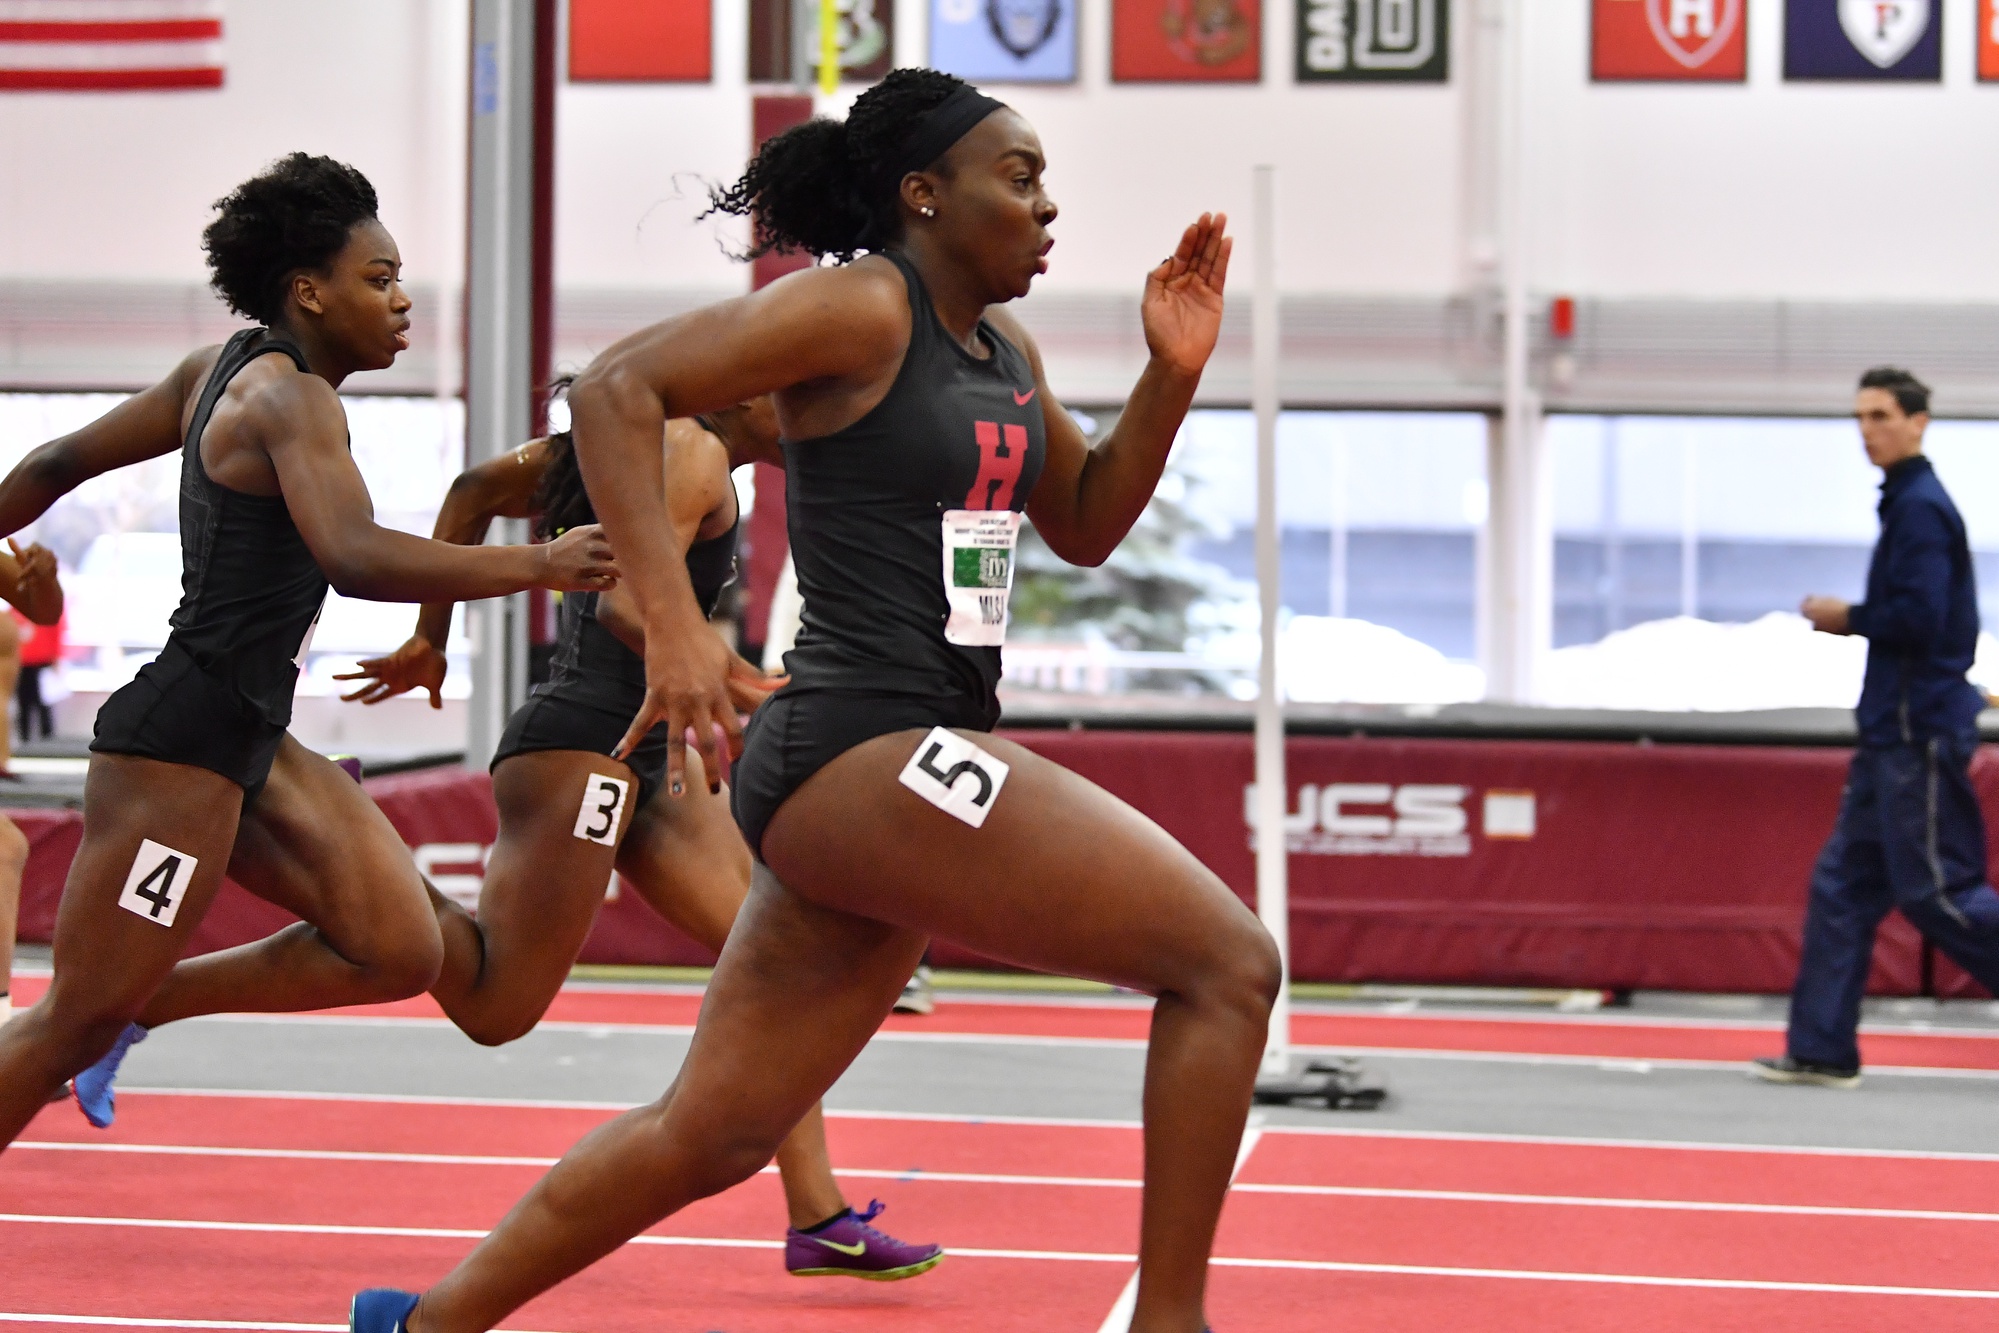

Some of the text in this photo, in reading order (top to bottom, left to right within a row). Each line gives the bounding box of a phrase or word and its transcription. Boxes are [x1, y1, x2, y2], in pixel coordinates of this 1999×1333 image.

[1669, 0, 1714, 38] H
[1875, 3, 1900, 39] P
[965, 421, 1028, 510] H
[916, 741, 992, 808] 5
[585, 782, 621, 840] 3
[1244, 782, 1470, 835] UCS
[135, 855, 181, 917] 4
